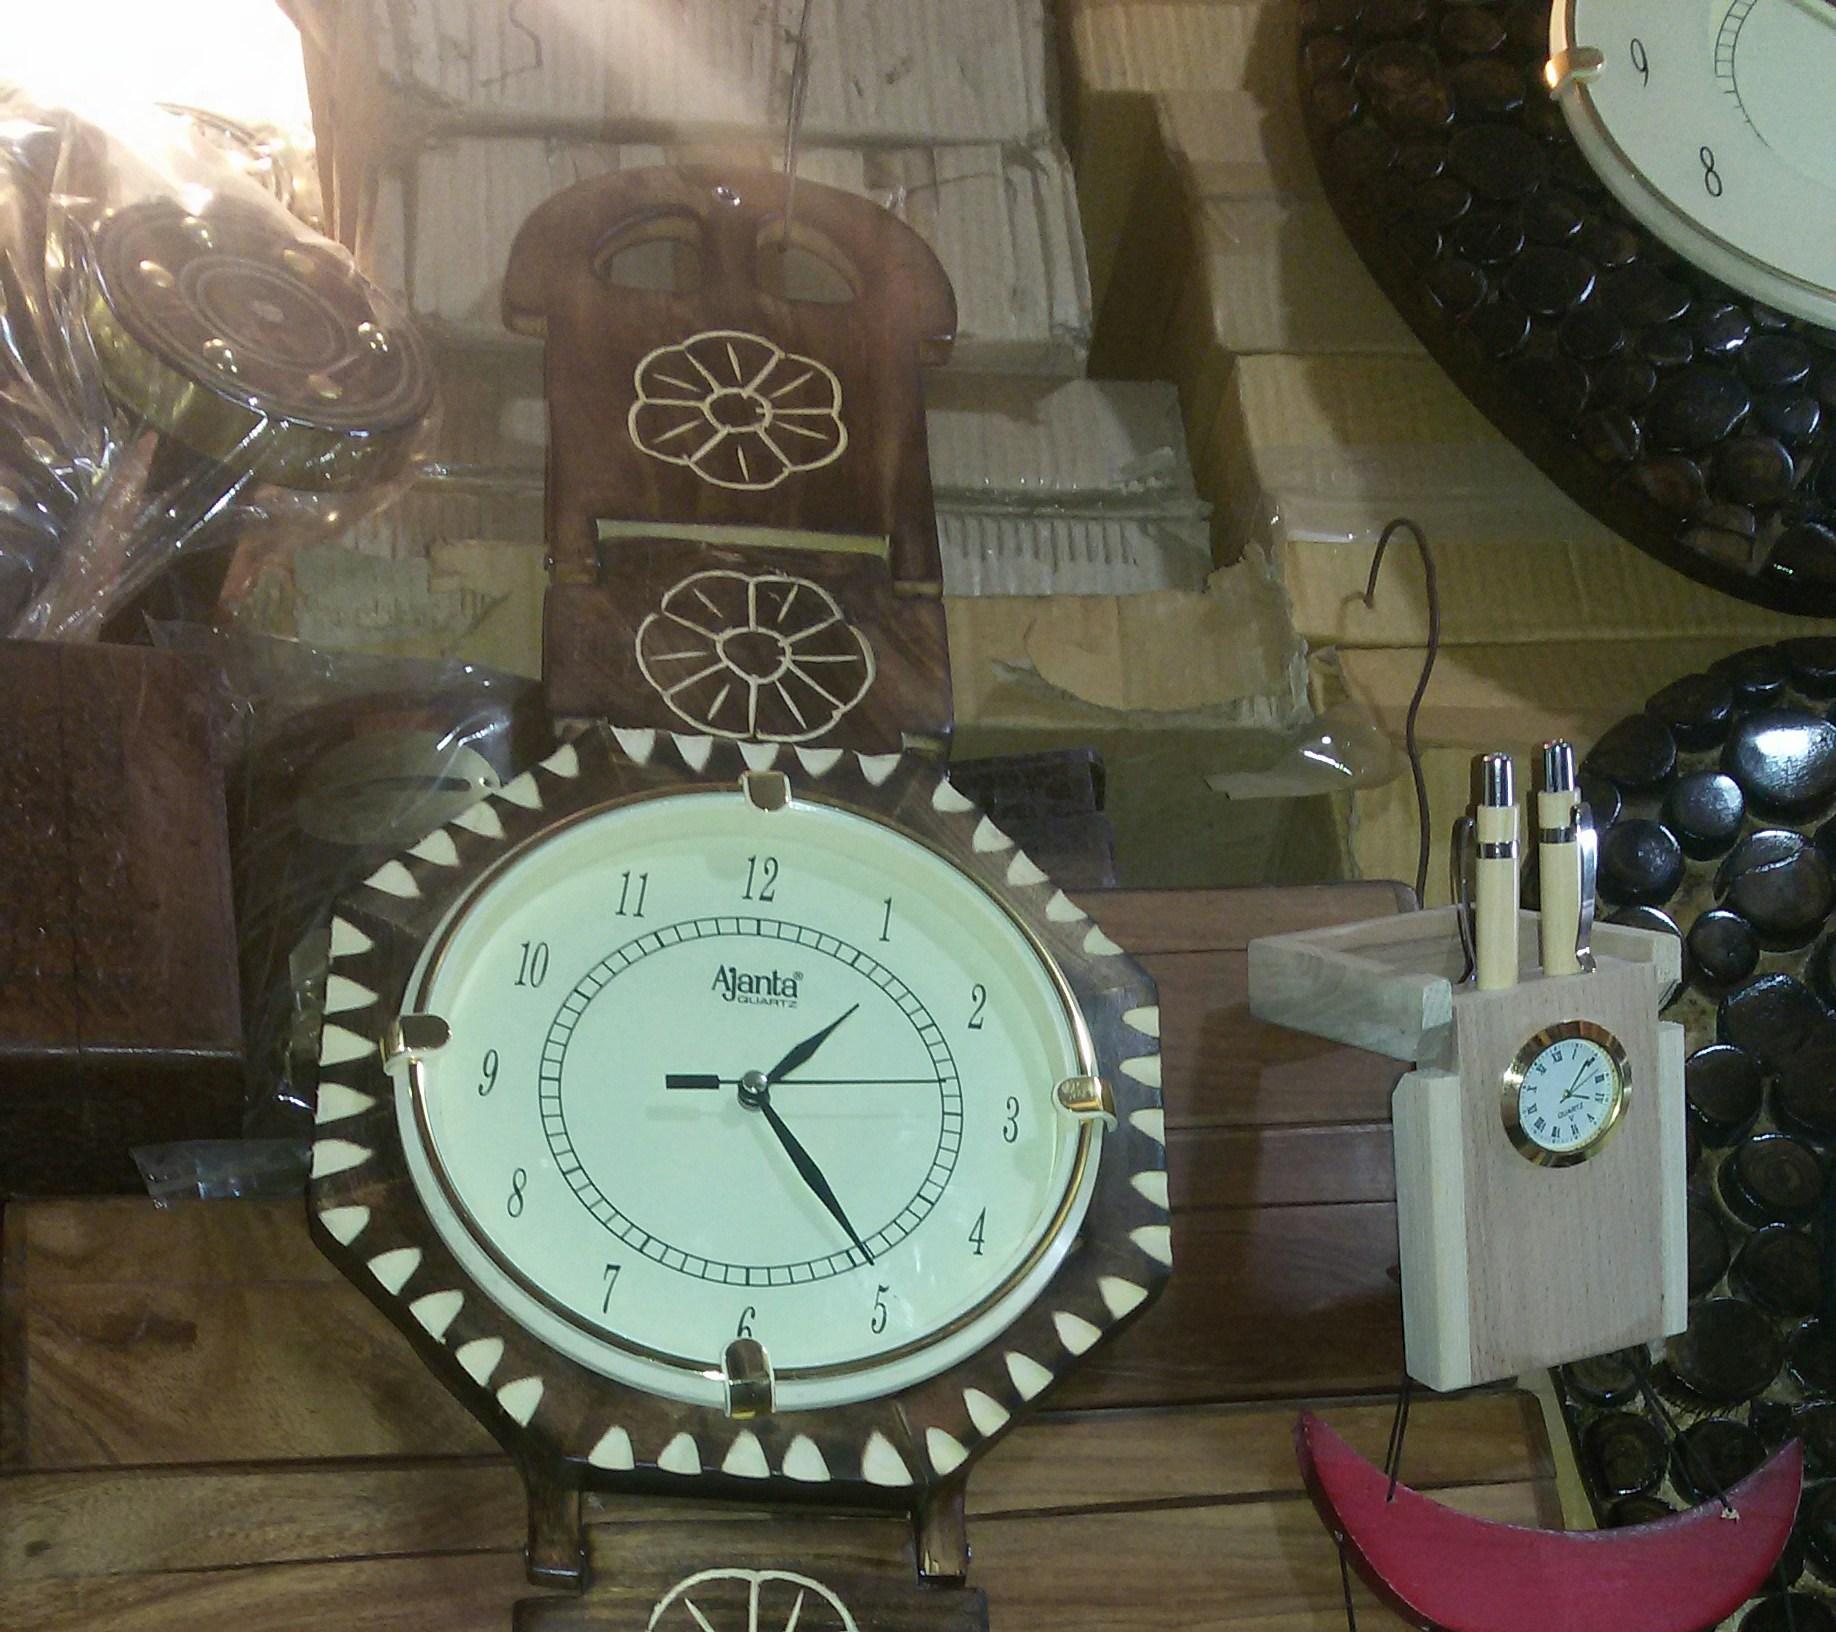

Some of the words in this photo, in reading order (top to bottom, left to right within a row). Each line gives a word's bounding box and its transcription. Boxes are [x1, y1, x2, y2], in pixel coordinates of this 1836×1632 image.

[1629, 37, 1650, 89] 9
[1699, 145, 1724, 198] 8
[614, 870, 650, 919] 11
[741, 854, 780, 903] 12
[878, 896, 894, 943] 1
[513, 940, 551, 989] 10
[711, 963, 799, 1002] Ajanta
[737, 994, 798, 1009] QUARTZ
[967, 983, 988, 1031] 2
[477, 1048, 500, 1097] 9
[1002, 1095, 1021, 1144] 3
[506, 1167, 529, 1219] 8
[967, 1205, 988, 1257] 4
[602, 1263, 622, 1315] 7
[870, 1284, 892, 1335] 5
[736, 1305, 757, 1338] 6
